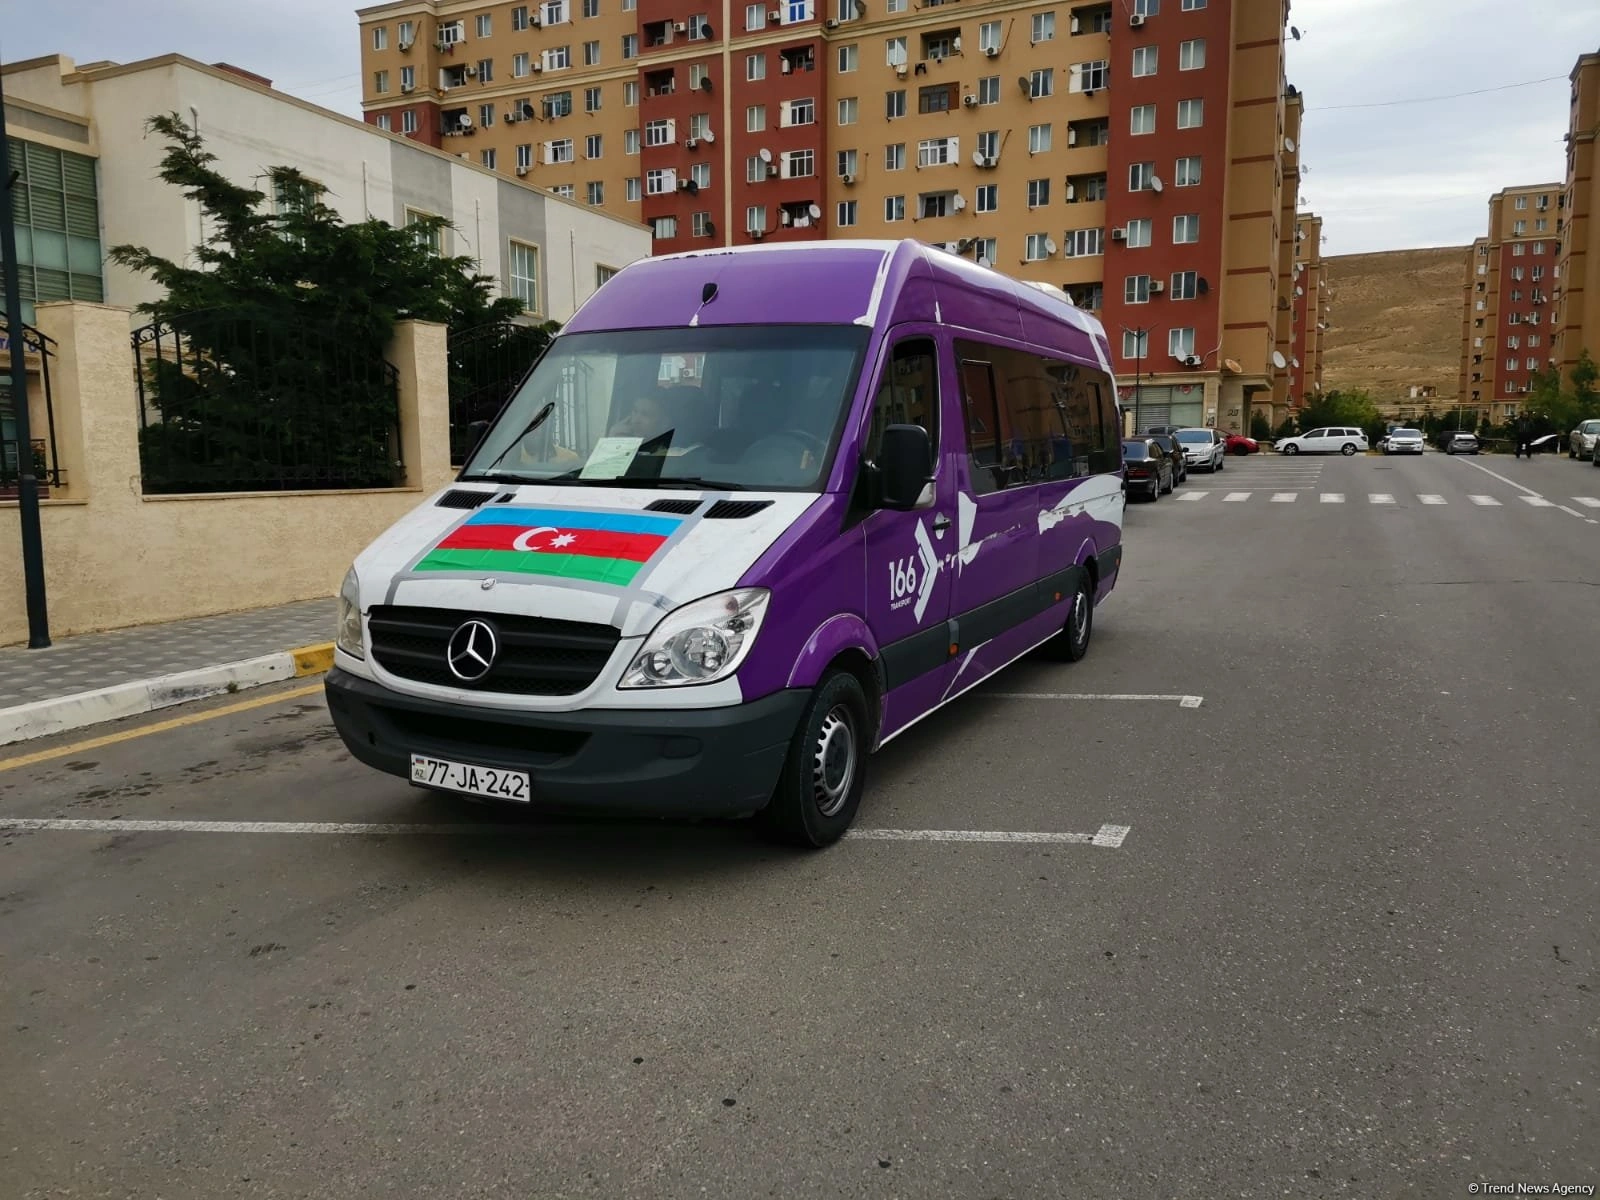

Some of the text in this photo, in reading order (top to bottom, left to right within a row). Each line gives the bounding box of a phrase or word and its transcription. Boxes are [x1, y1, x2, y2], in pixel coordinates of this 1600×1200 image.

[889, 556, 916, 600] 166
[415, 768, 424, 778] AZ
[428, 760, 524, 798] 77-JA-242
